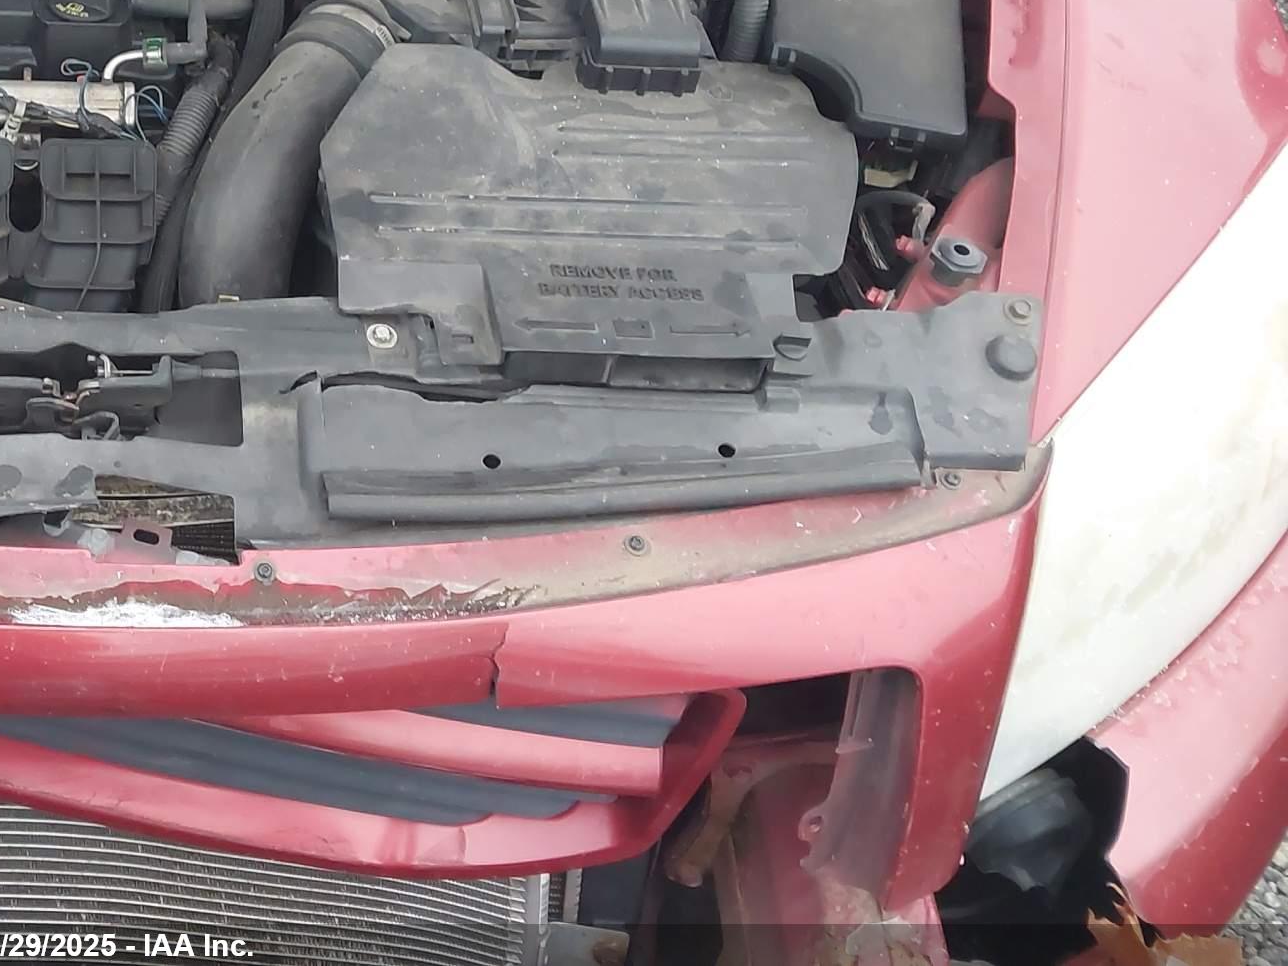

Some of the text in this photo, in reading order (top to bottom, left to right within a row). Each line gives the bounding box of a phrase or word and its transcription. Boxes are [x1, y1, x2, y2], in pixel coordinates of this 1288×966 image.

[549, 264, 678, 282] REMOVE FOR
[537, 282, 705, 301] BATTERY ACCESS
